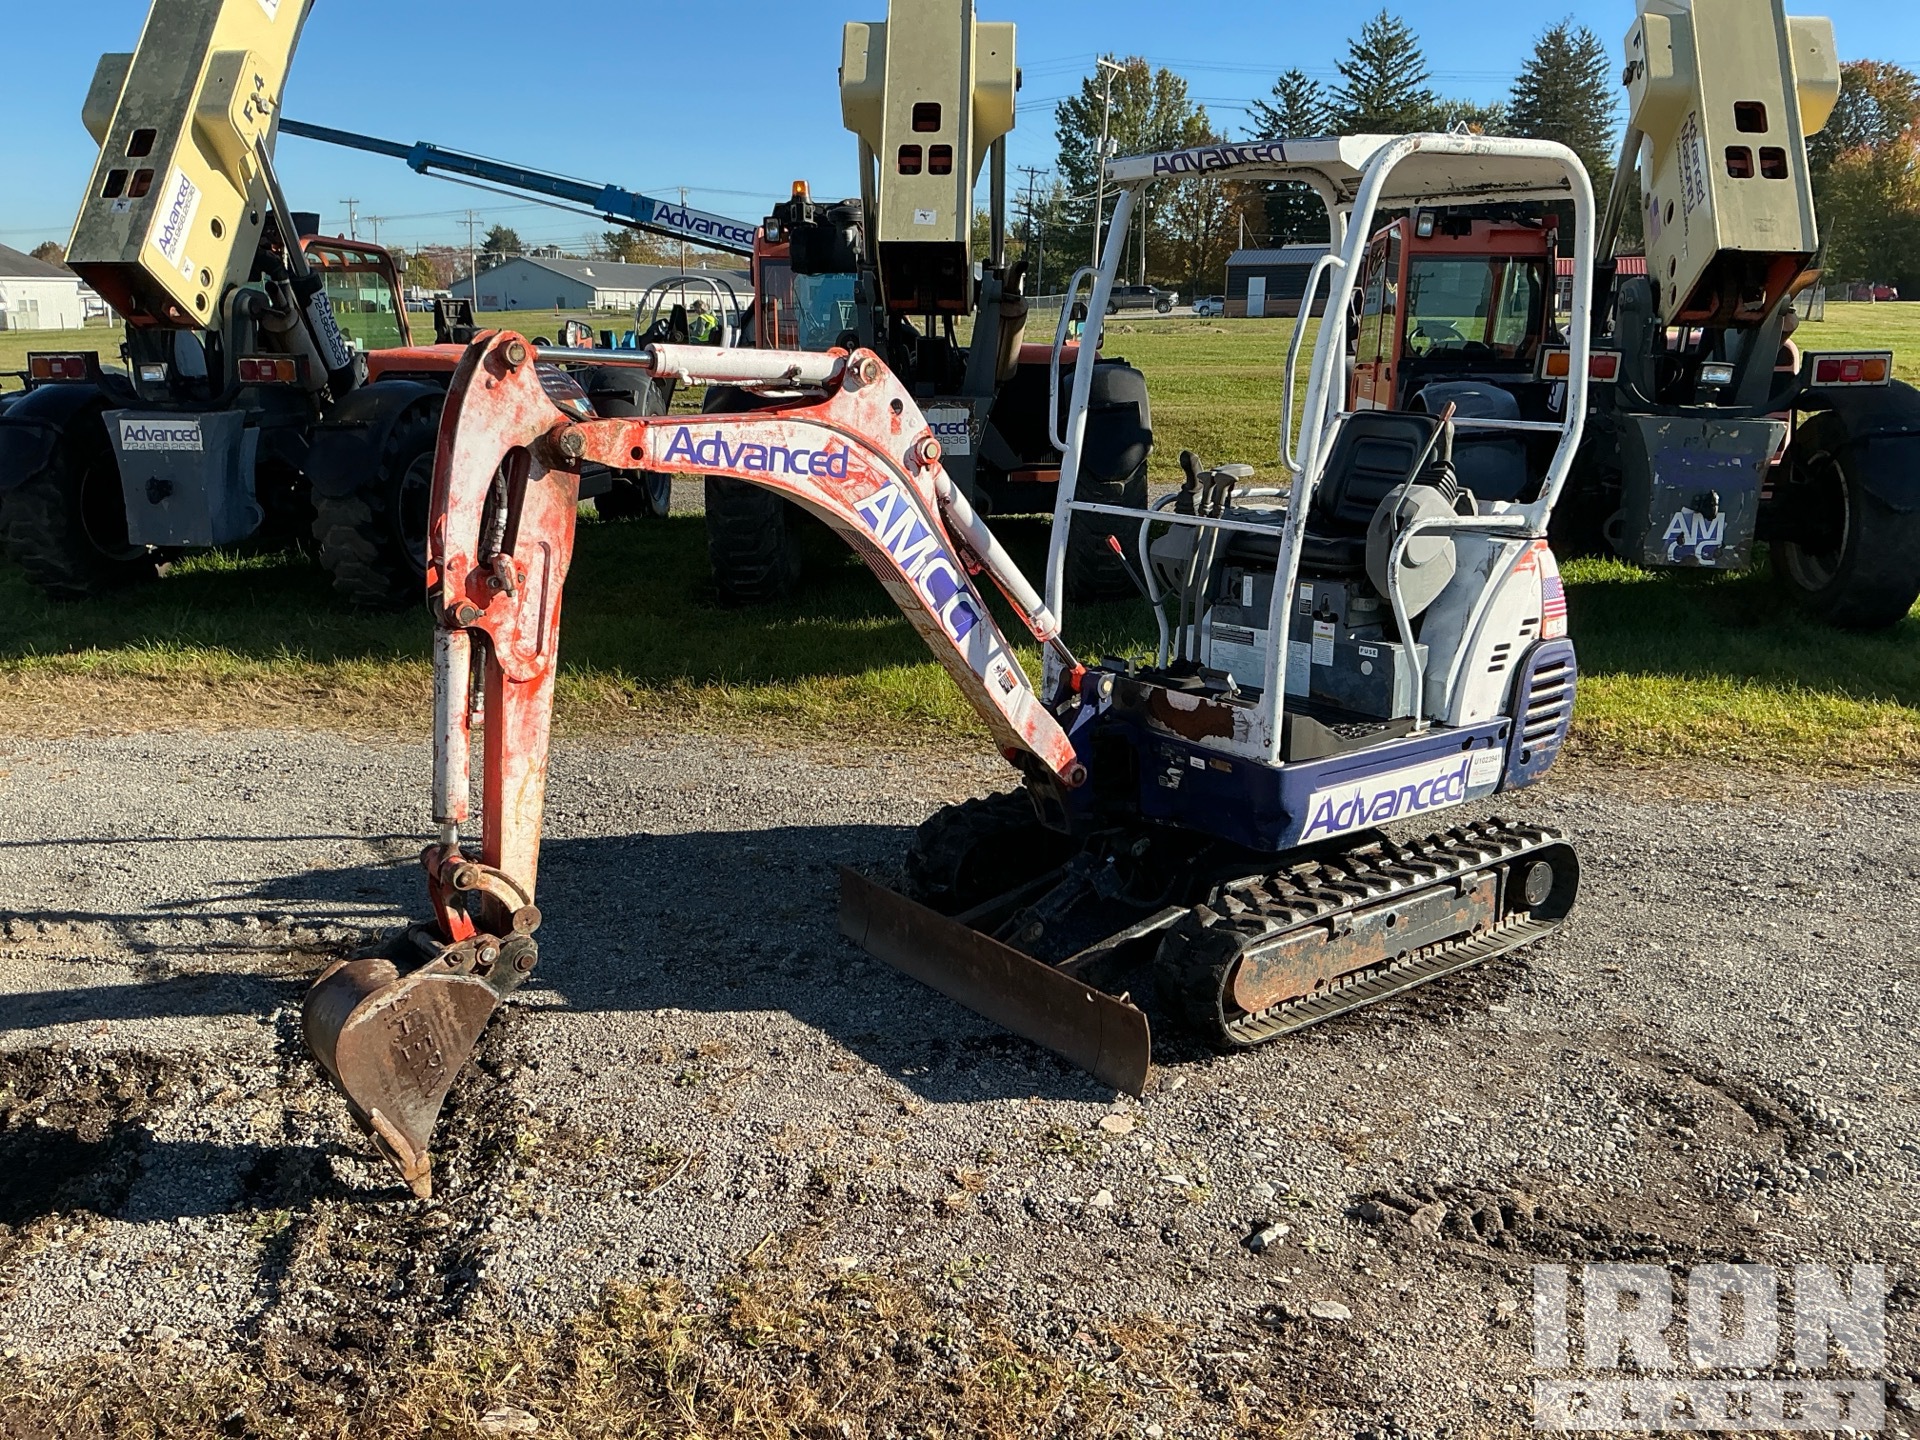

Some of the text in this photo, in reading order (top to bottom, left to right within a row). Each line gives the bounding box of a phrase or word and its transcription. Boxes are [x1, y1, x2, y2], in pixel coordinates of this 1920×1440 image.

[1153, 143, 1288, 177] Advanced
[1681, 121, 1696, 215] Masonry
[1688, 109, 1706, 207] Advanced
[158, 173, 192, 256] Advanced
[653, 204, 757, 245] Advanced
[124, 425, 200, 442] Advanced
[664, 427, 850, 479] Advanced
[1360, 648, 1377, 656] FUSE
[1302, 759, 1469, 840] Advanced
